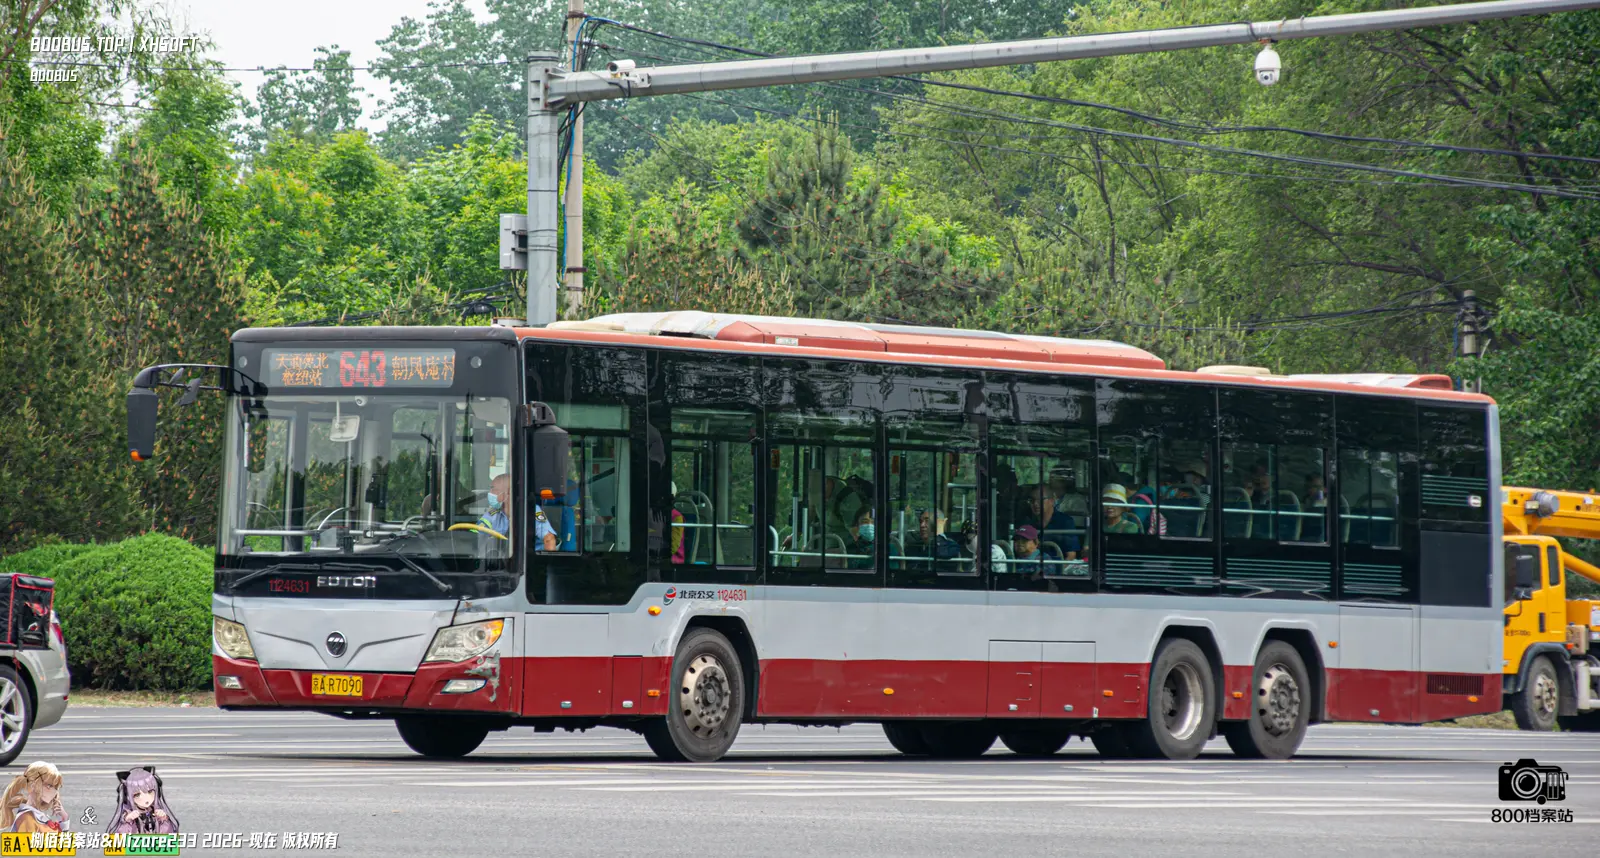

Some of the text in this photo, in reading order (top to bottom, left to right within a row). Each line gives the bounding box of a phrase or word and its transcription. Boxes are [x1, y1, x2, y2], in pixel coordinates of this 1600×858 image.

[339, 351, 386, 387] 643
[269, 579, 310, 593] 1124631
[317, 576, 376, 588] FOTON
[679, 590, 715, 600] 北京公交
[717, 589, 747, 602] 1124631
